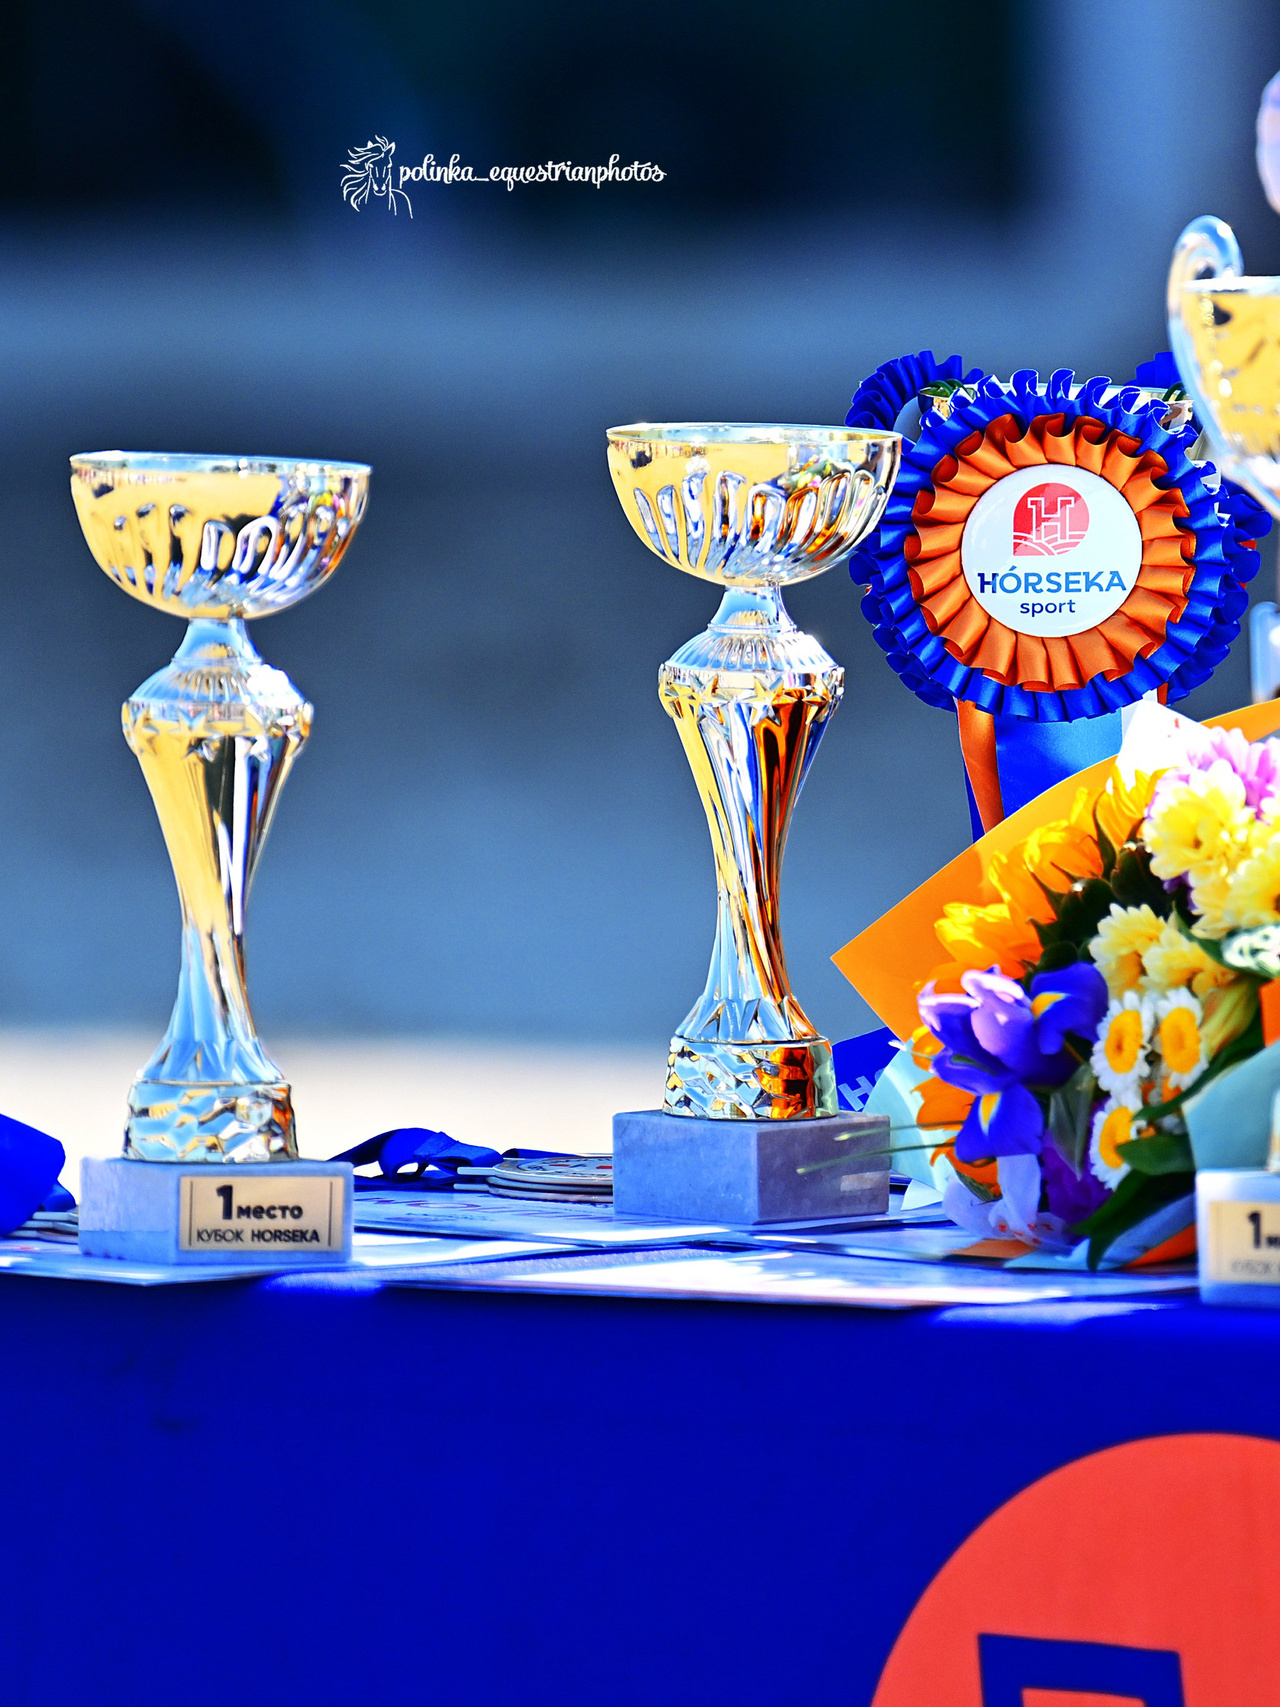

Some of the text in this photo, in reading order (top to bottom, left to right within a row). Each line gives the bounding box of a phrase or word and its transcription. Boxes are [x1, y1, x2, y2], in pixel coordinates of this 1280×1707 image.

[1027, 496, 1076, 544] H
[977, 564, 1128, 595] HÓRSEKA
[1019, 599, 1076, 617] sport
[216, 1184, 304, 1221] 1 место
[196, 1228, 321, 1243] КУБОК HORSEKA
[1248, 1210, 1262, 1249] 1
